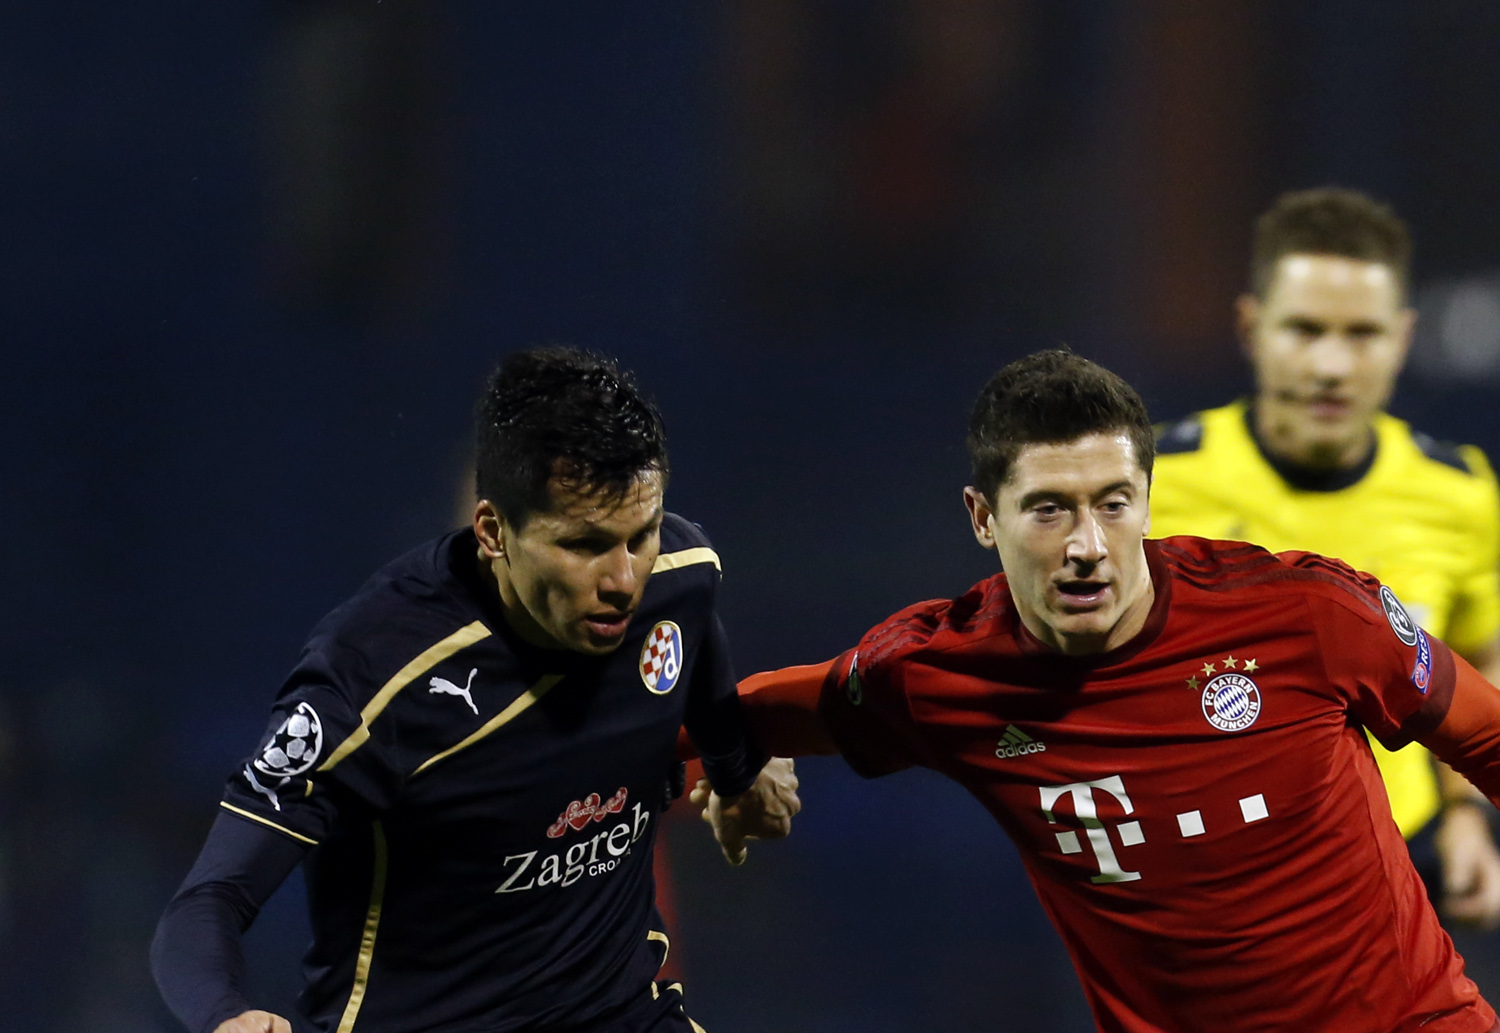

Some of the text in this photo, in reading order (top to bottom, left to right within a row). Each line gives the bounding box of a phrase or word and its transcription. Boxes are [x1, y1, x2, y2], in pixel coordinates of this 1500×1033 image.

[1205, 676, 1254, 706] FC BAYERN
[995, 741, 1047, 759] adidas
[494, 801, 650, 894] Zagreb
